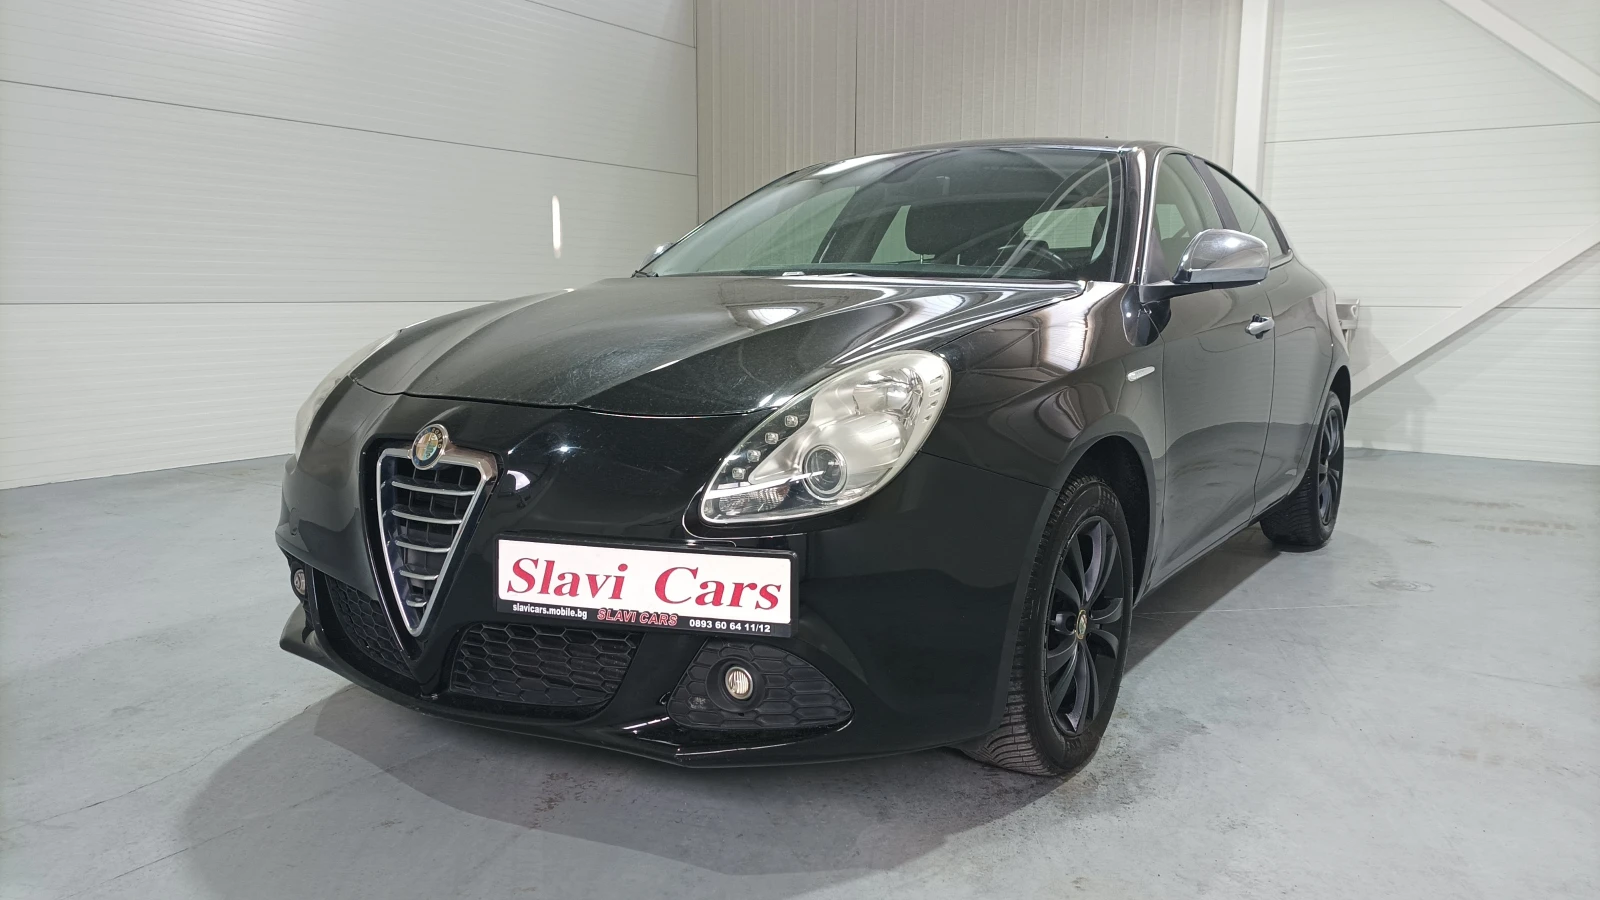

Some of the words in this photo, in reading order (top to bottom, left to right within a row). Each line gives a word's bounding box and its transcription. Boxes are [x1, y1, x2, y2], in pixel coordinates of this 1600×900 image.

[506, 557, 628, 600] Slavi
[654, 567, 782, 611] Cars
[512, 603, 588, 620] slavicars.mobile.bg
[597, 609, 637, 624] SLAVI
[639, 611, 679, 627] CARS
[689, 619, 713, 629] 0893
[715, 620, 728, 630] 60
[729, 621, 742, 631] 64
[744, 623, 771, 633] 11/12
